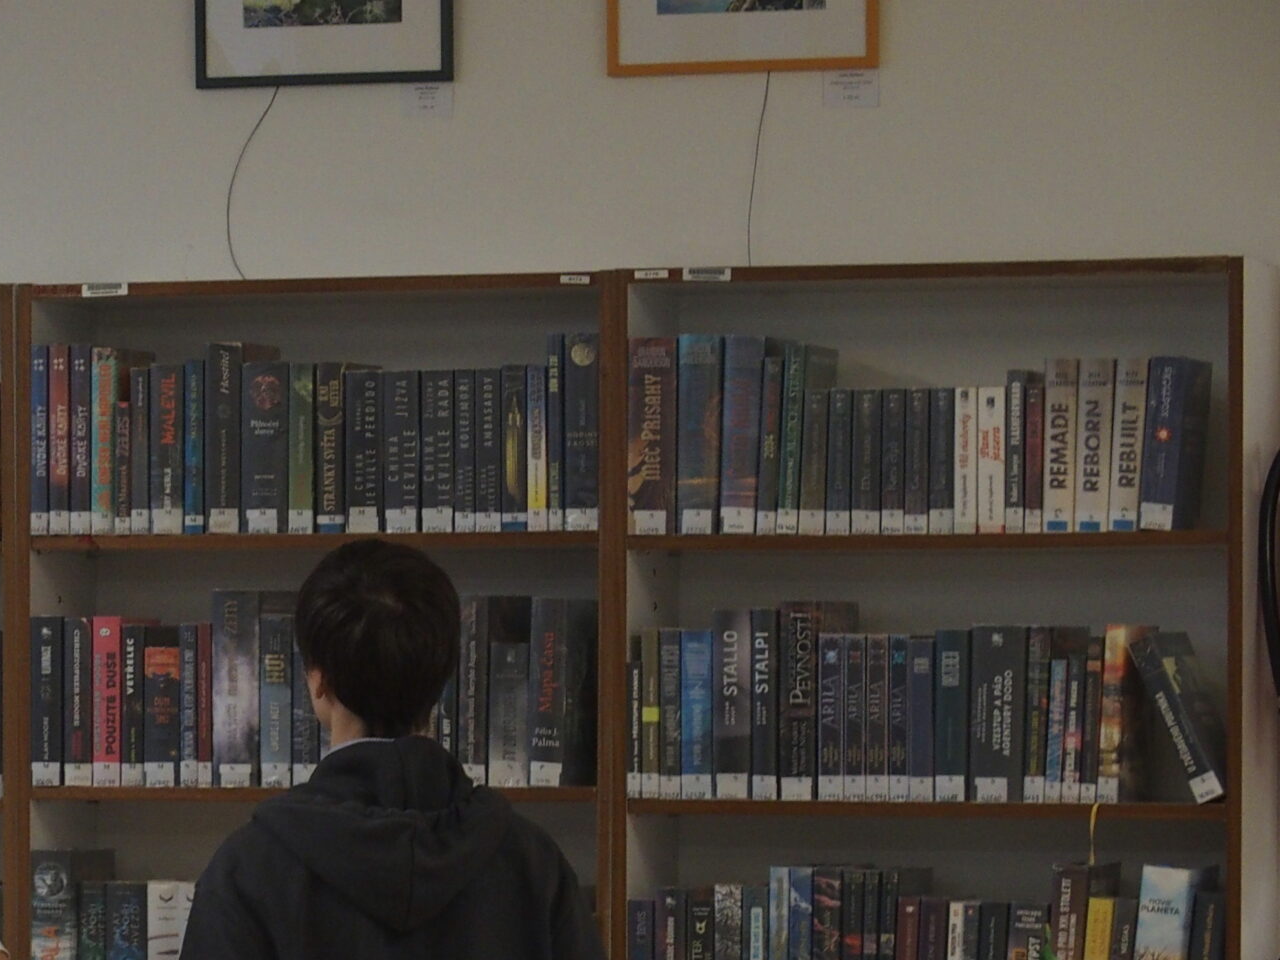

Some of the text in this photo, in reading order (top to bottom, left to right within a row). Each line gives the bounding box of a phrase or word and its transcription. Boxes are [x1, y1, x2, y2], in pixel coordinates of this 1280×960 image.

[161, 374, 176, 446] MALEVIL
[365, 380, 376, 439] PERDIDO
[395, 380, 408, 418] JIZVA
[439, 379, 450, 417] RADA
[321, 428, 336, 512] STRÁNKY SVĚTA
[355, 454, 363, 491] CHINA
[388, 435, 400, 482] CHINA
[424, 435, 435, 482] CHINA
[1049, 403, 1069, 490] REMADE
[1083, 400, 1100, 492] REBORN
[1118, 401, 1139, 488] REBUILT
[124, 637, 135, 695] VETŘELEC
[536, 631, 560, 713] Mapa času
[723, 630, 738, 697] STALLO
[754, 632, 769, 695] STALPI
[788, 612, 812, 706] PEVNOSTI
[104, 651, 117, 755] POUŽITÉ DUŠE
[821, 676, 839, 729] ARILA
[847, 682, 861, 722] ARILA
[869, 681, 881, 723] ARILA
[891, 684, 906, 730] ARILA
[1003, 669, 1014, 756] AGENTURY DODO
[1140, 905, 1180, 916] PLANETA
